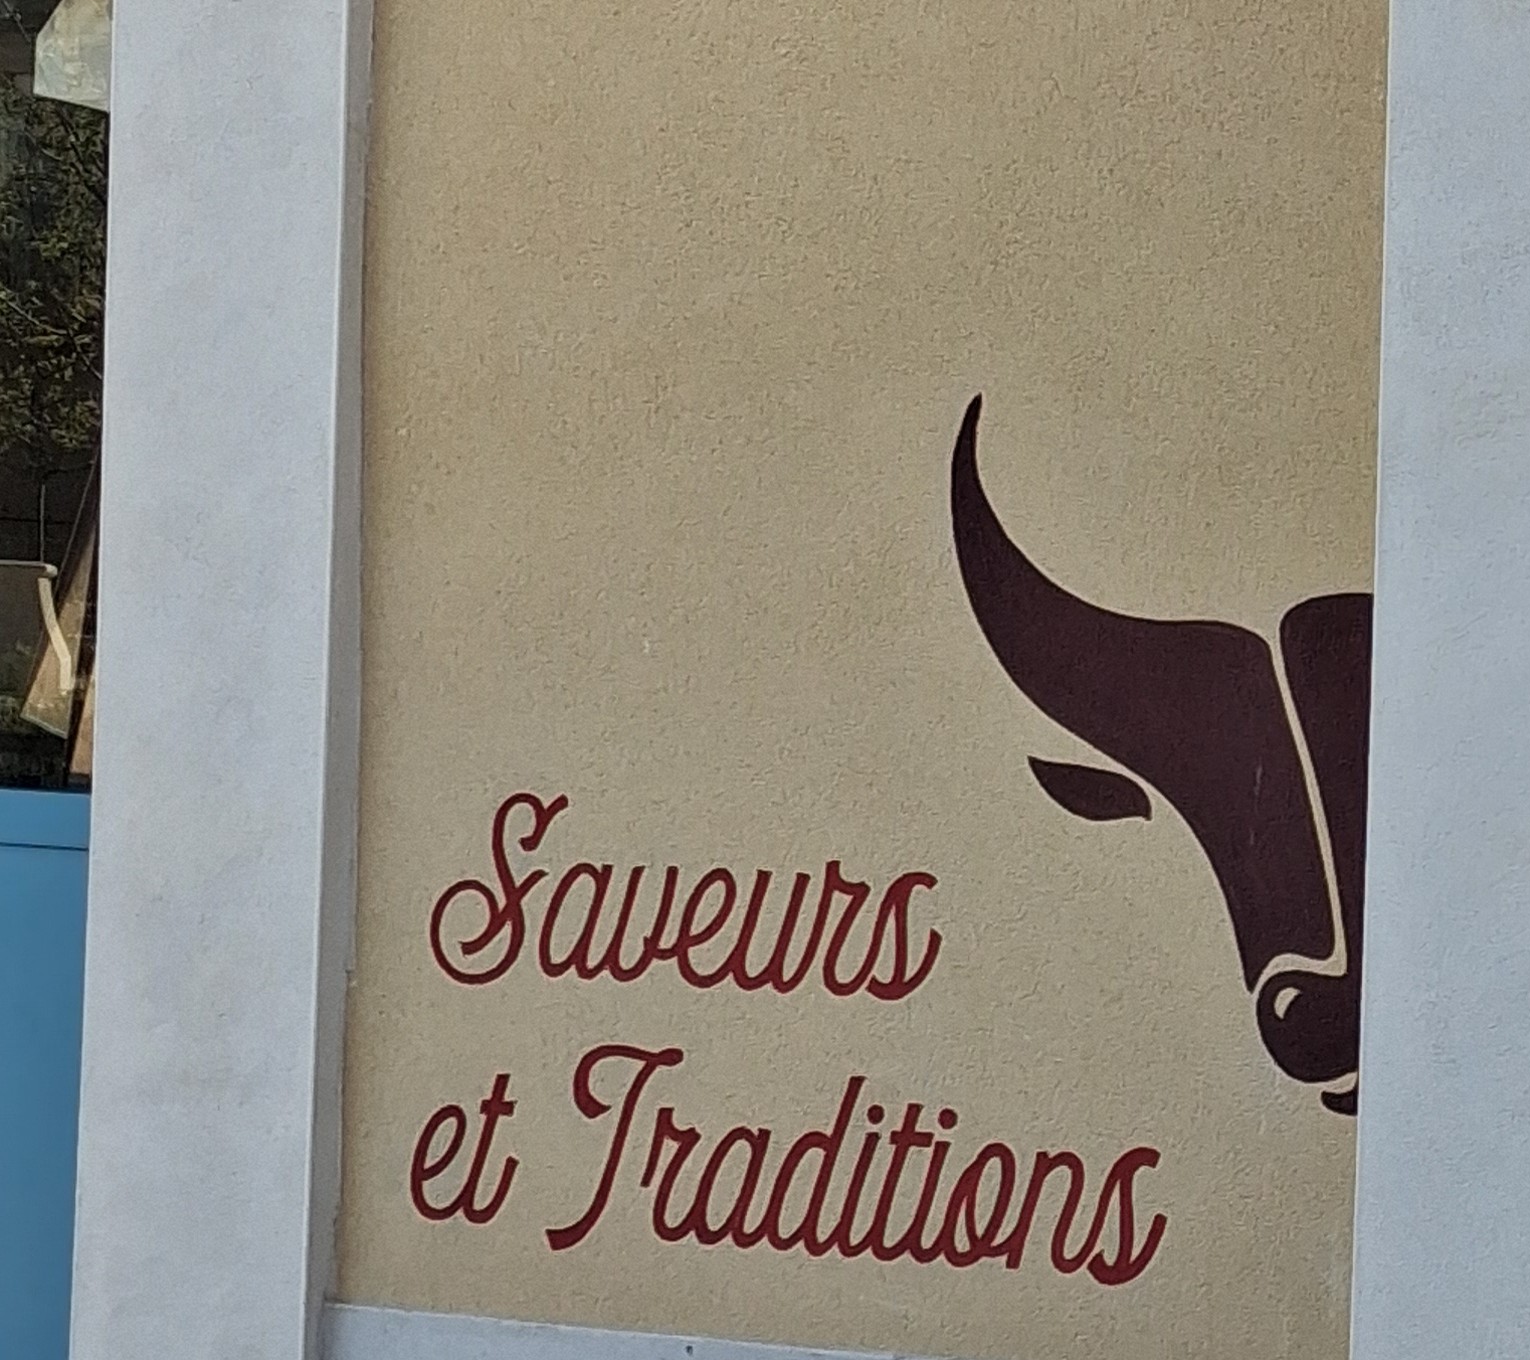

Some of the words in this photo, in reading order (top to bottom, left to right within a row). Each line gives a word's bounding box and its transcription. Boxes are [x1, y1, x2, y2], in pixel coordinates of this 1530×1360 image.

[429, 792, 942, 1002] Saveurs
[409, 1072, 519, 1225] et
[545, 1044, 1168, 1286] Traditions
